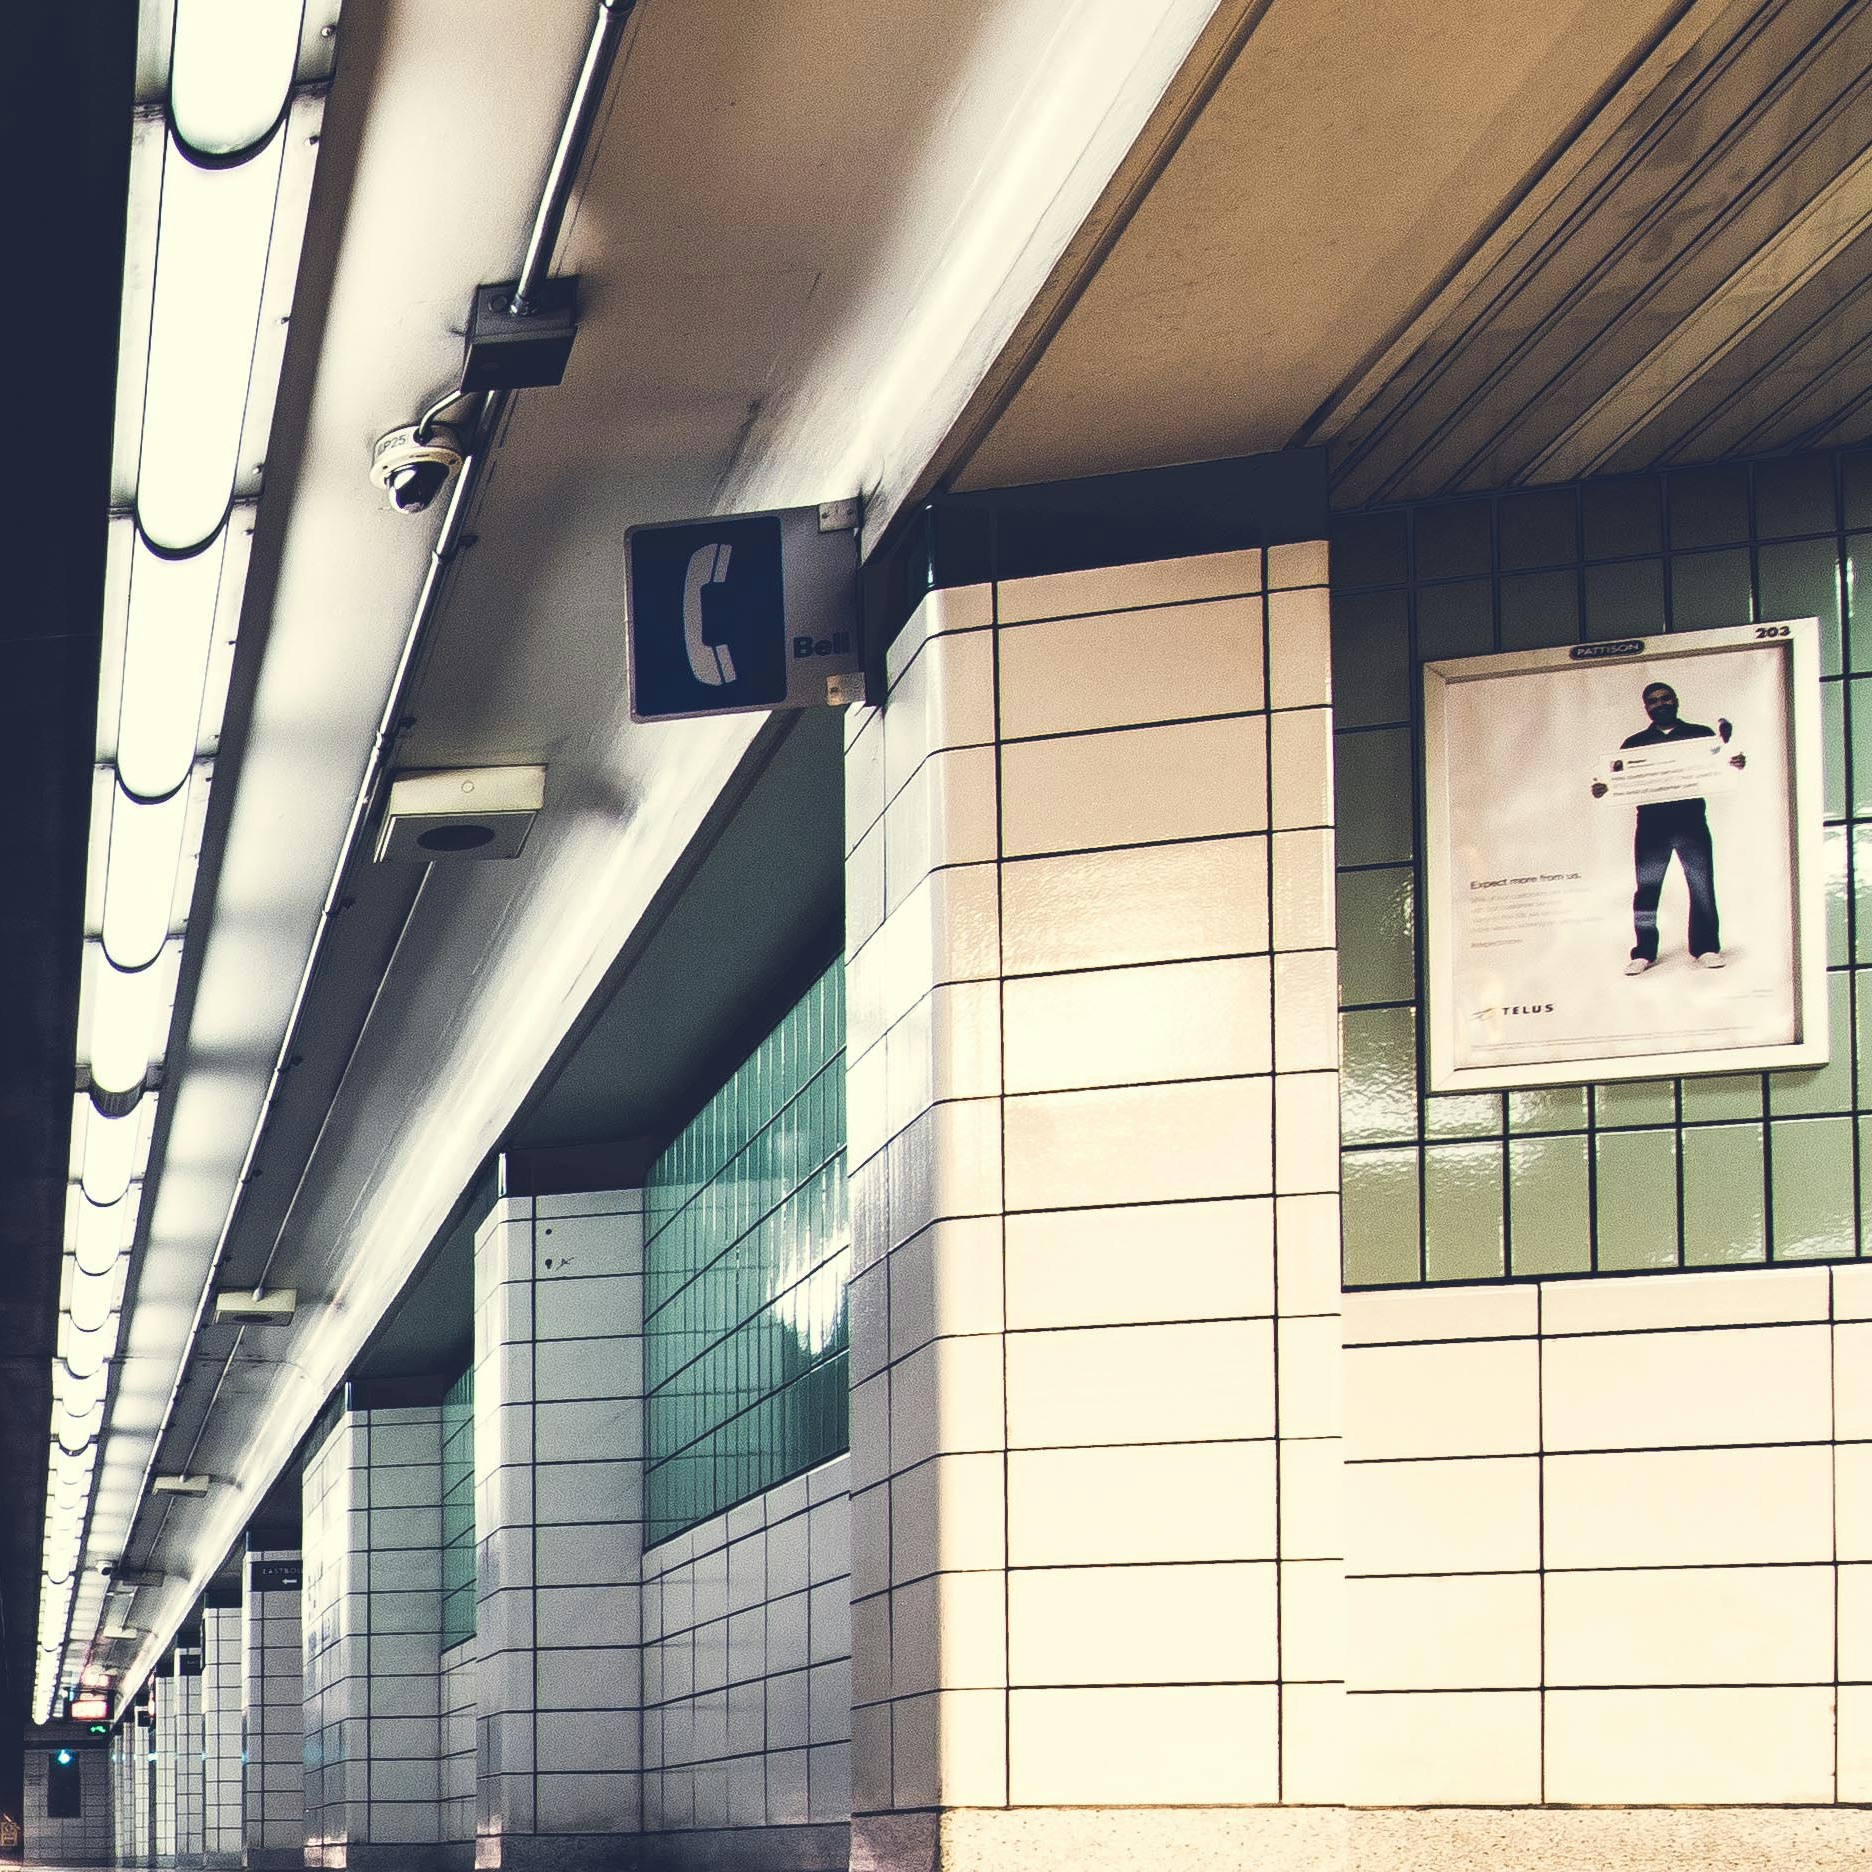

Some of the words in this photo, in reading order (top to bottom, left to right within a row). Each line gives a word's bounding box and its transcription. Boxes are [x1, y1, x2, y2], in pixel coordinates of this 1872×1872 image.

[1755, 625, 1791, 639] 203
[794, 631, 849, 658] Bell
[1577, 643, 1639, 656] PATTISON
[1470, 879, 1508, 890] Expect
[1502, 1003, 1555, 1016] TELUS
